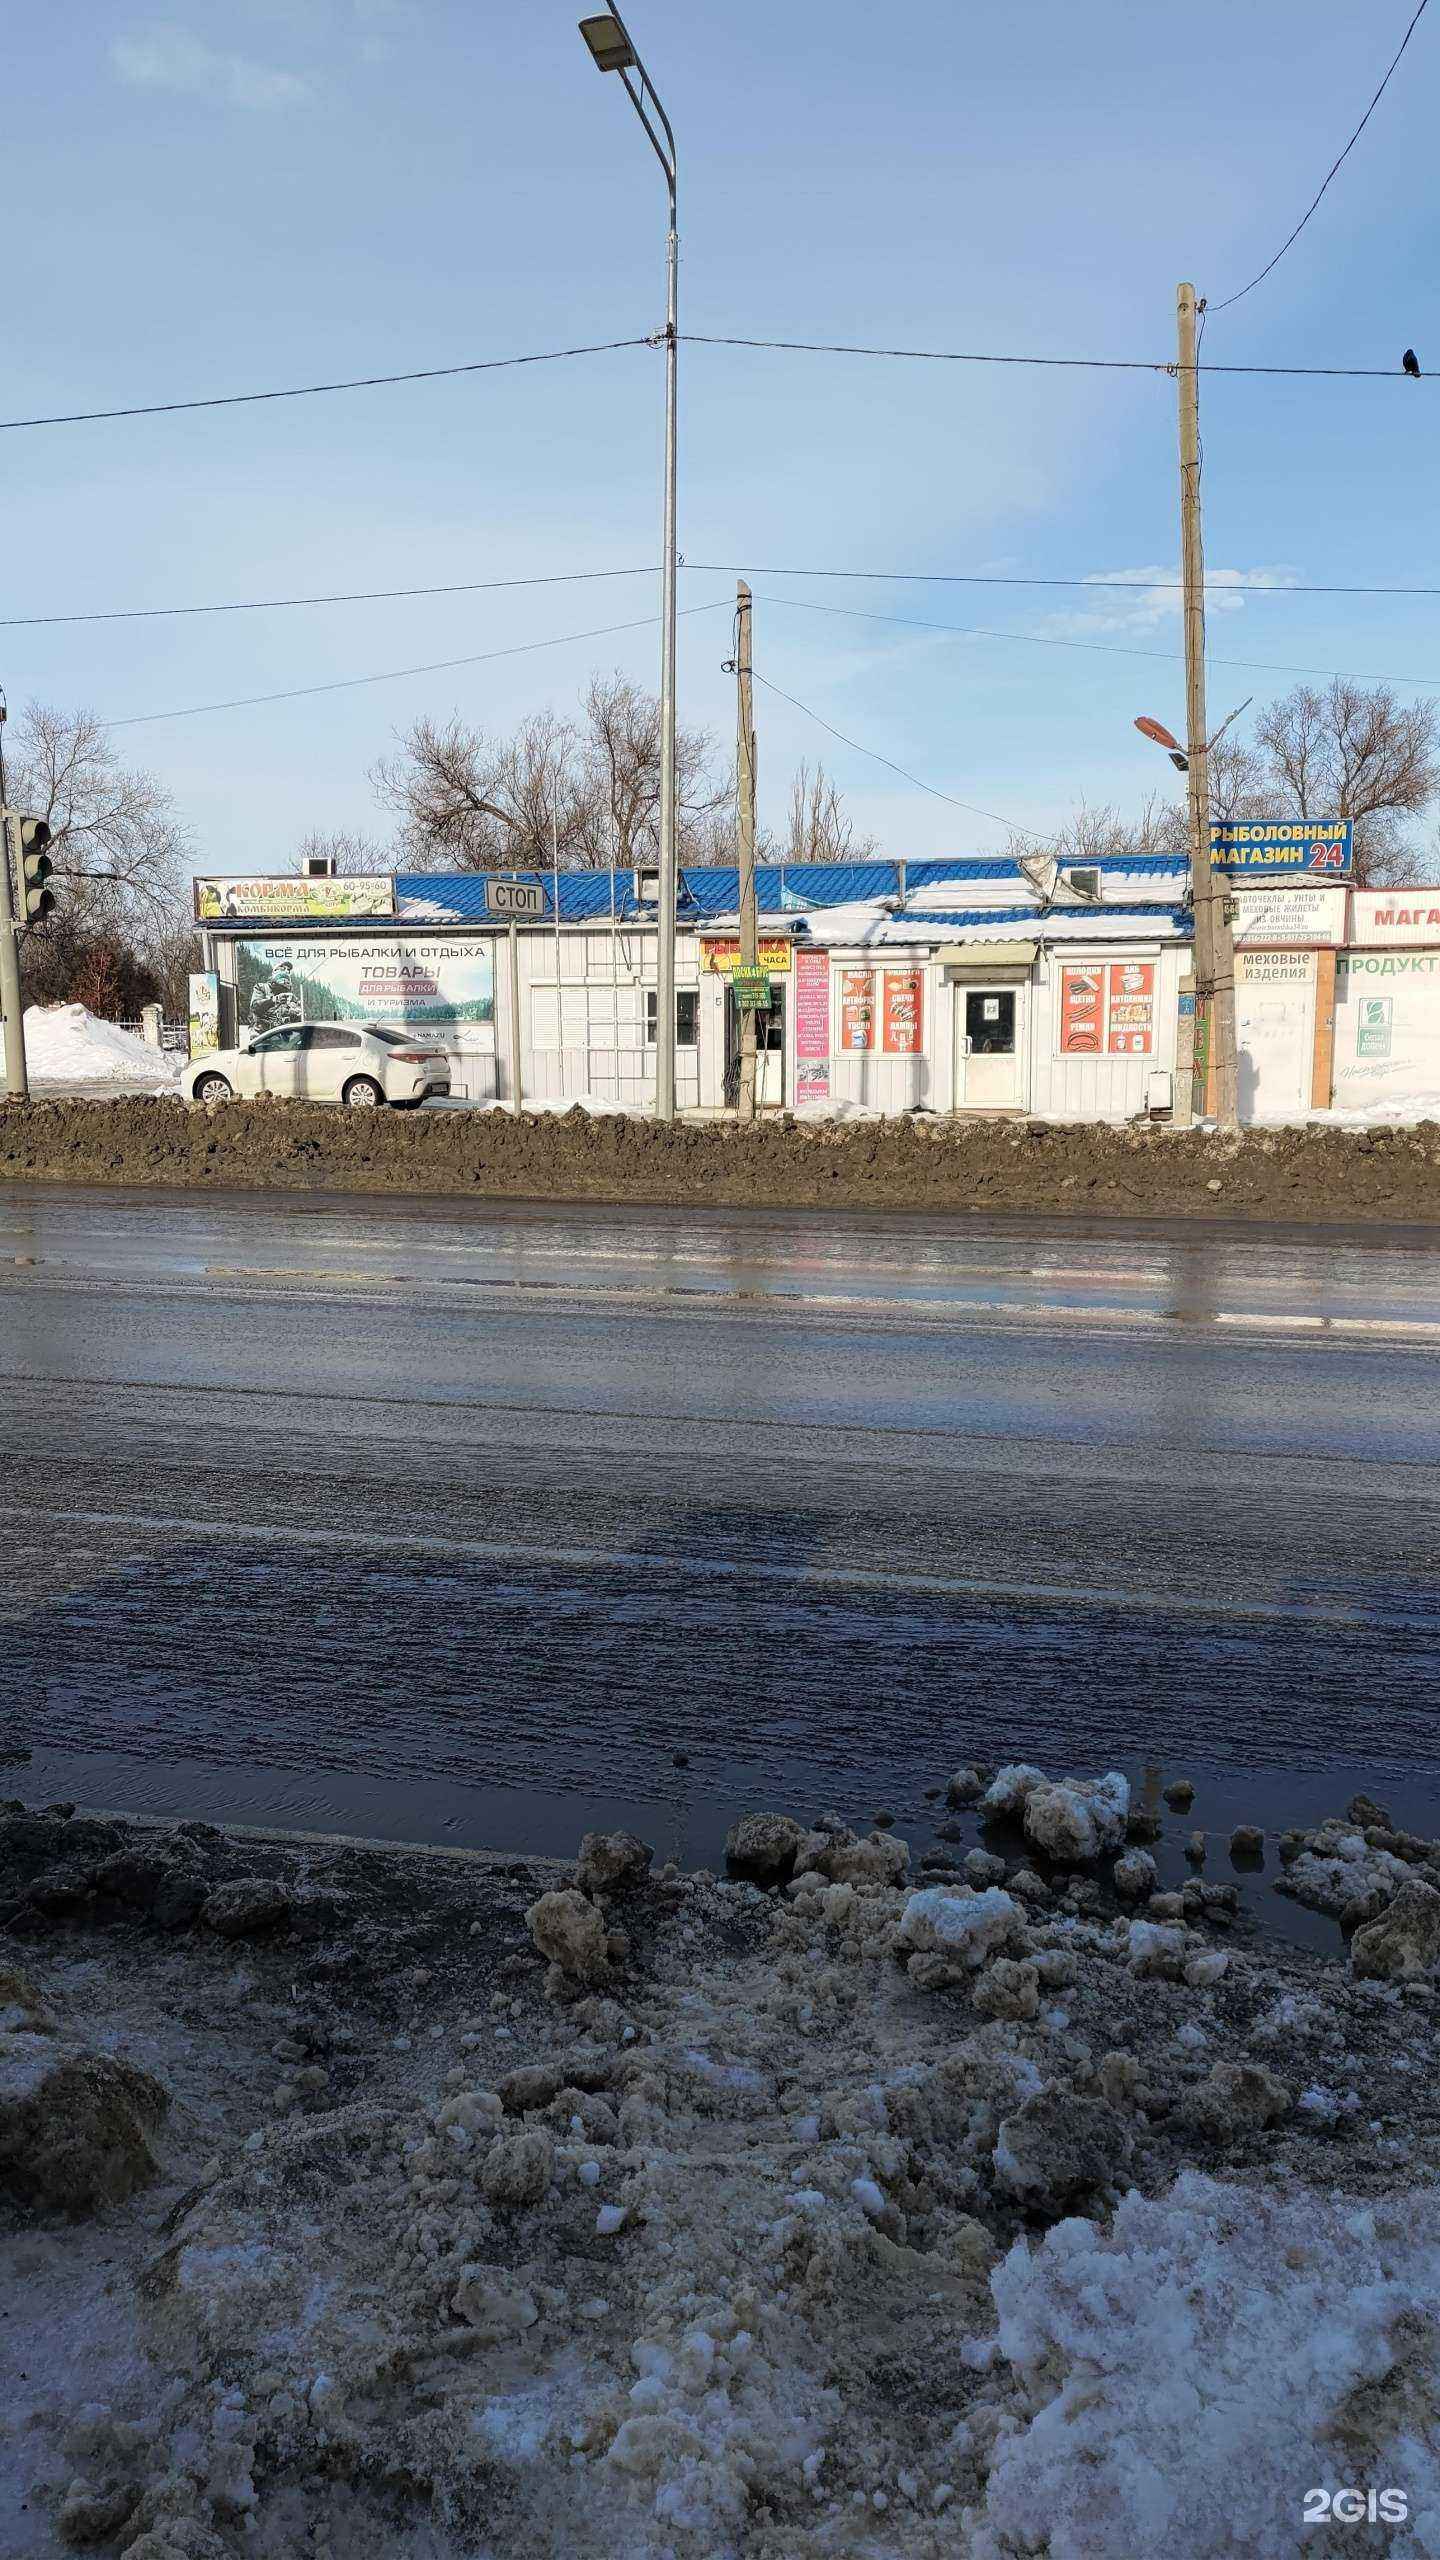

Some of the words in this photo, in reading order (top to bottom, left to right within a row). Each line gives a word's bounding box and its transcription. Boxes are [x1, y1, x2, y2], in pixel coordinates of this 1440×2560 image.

[1210, 822, 1347, 841] РЫБОЛОВНЫЙ
[1210, 847, 1303, 864] МАГАЗИН
[1309, 843, 1344, 868] 24
[235, 883, 310, 898] КОРМА
[343, 881, 387, 891] 60-95-60
[496, 885, 537, 910] СТОП
[237, 904, 310, 914] КОМБИКОРМА
[1375, 909, 1440, 925] МАГА
[265, 946, 293, 958] ВСЁ
[297, 948, 326, 959] ДЛЯ
[330, 947, 402, 958] РЫБАЛКИ
[405, 947, 416, 957] И
[421, 947, 485, 959] ОТДЫХА
[361, 966, 441, 978] ТОВАРЫ
[361, 984, 384, 993] ДЛЯ
[385, 984, 437, 993] РЫБАЛКИ
